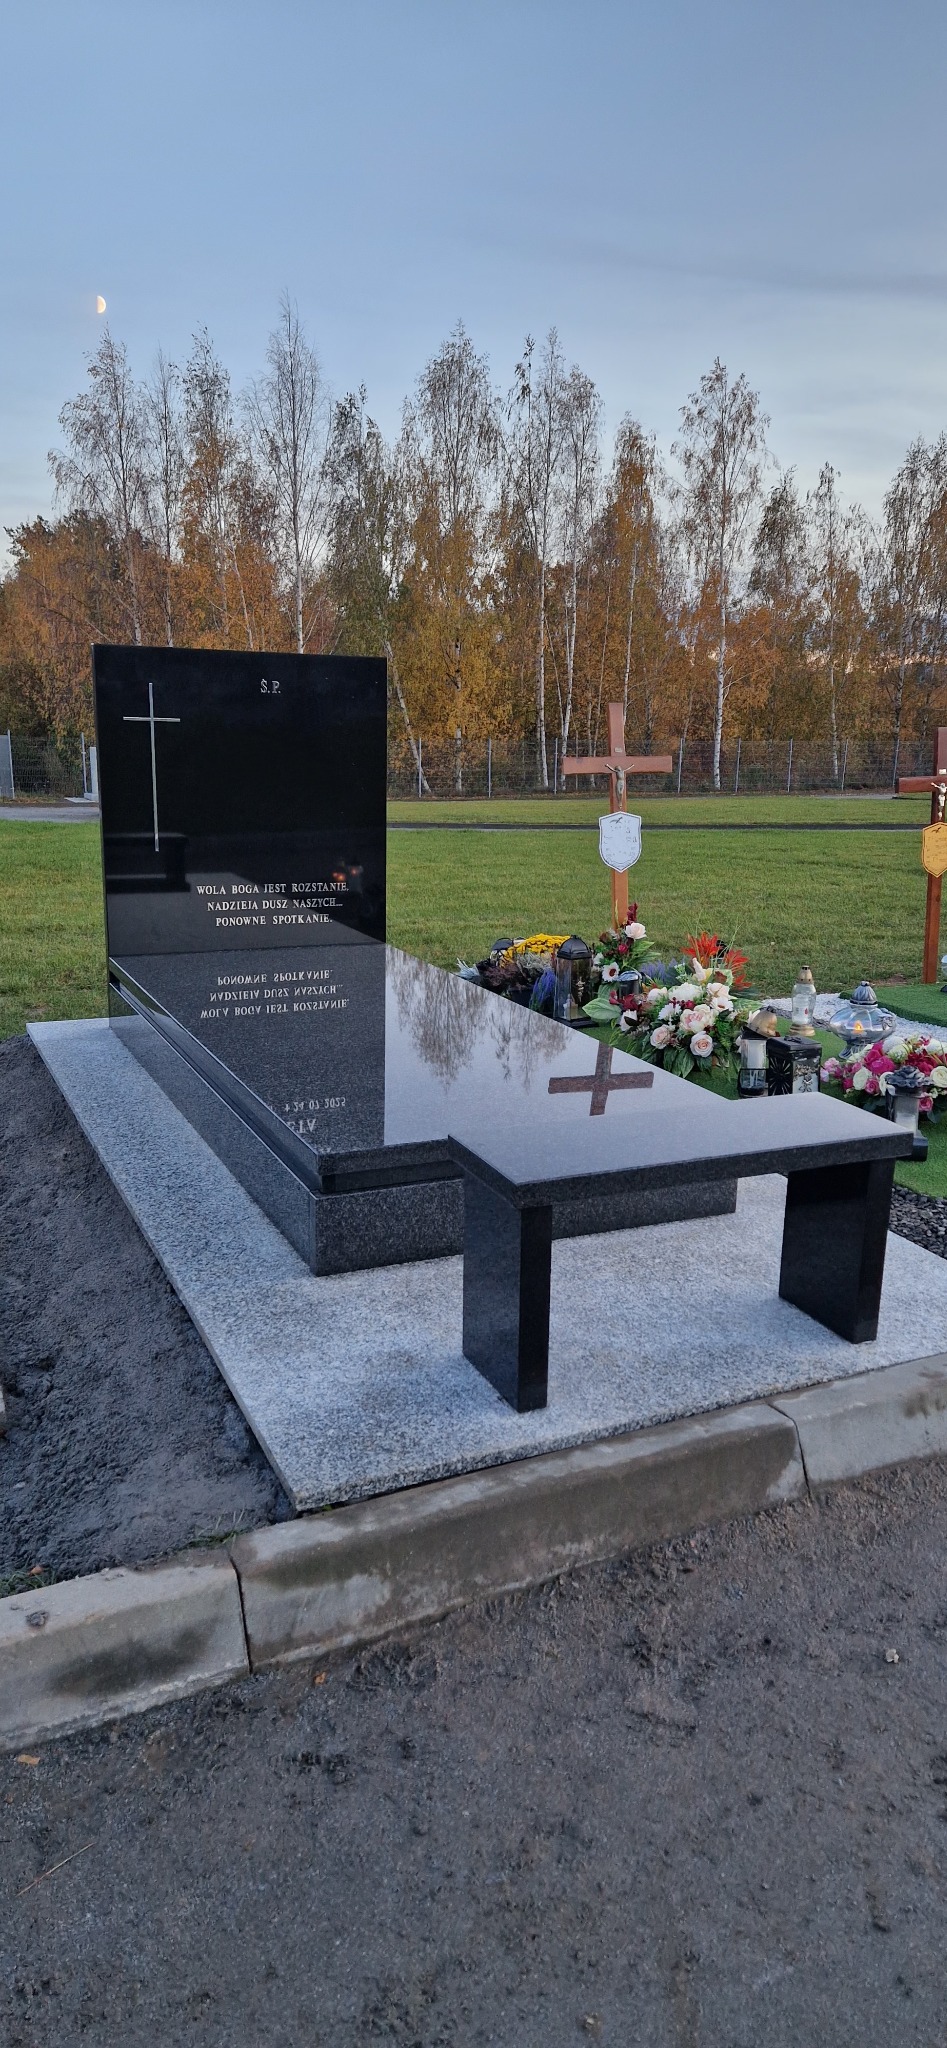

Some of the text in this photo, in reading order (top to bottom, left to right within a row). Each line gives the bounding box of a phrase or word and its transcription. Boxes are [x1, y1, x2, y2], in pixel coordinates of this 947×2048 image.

[231, 884, 260, 894] BOGA
[263, 883, 286, 893] JEST
[262, 899, 288, 909] DUSZ
[216, 913, 333, 926] PONOWNE SPOTKANIE.
